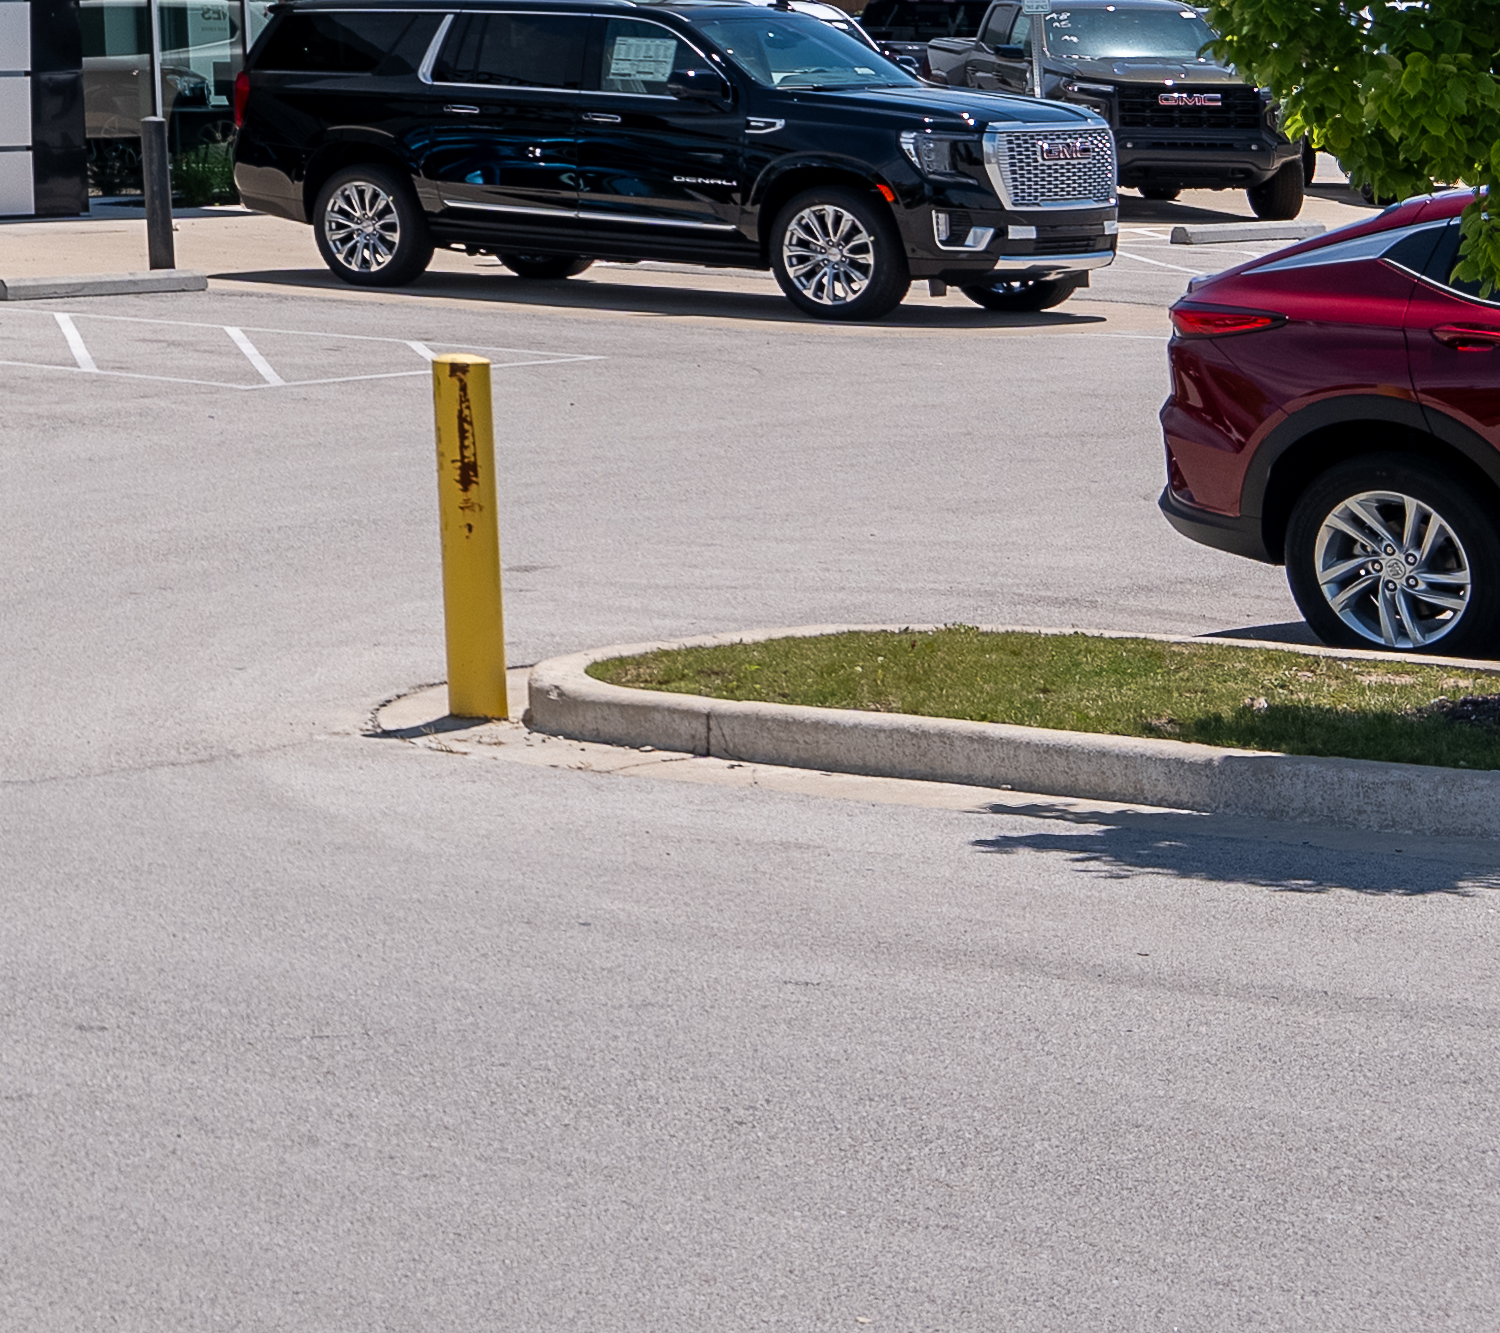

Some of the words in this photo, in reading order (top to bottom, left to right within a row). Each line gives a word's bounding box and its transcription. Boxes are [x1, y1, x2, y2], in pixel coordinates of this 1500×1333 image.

[1158, 93, 1222, 106] GMC
[1043, 141, 1092, 160] GMC
[673, 176, 737, 186] DENALI
